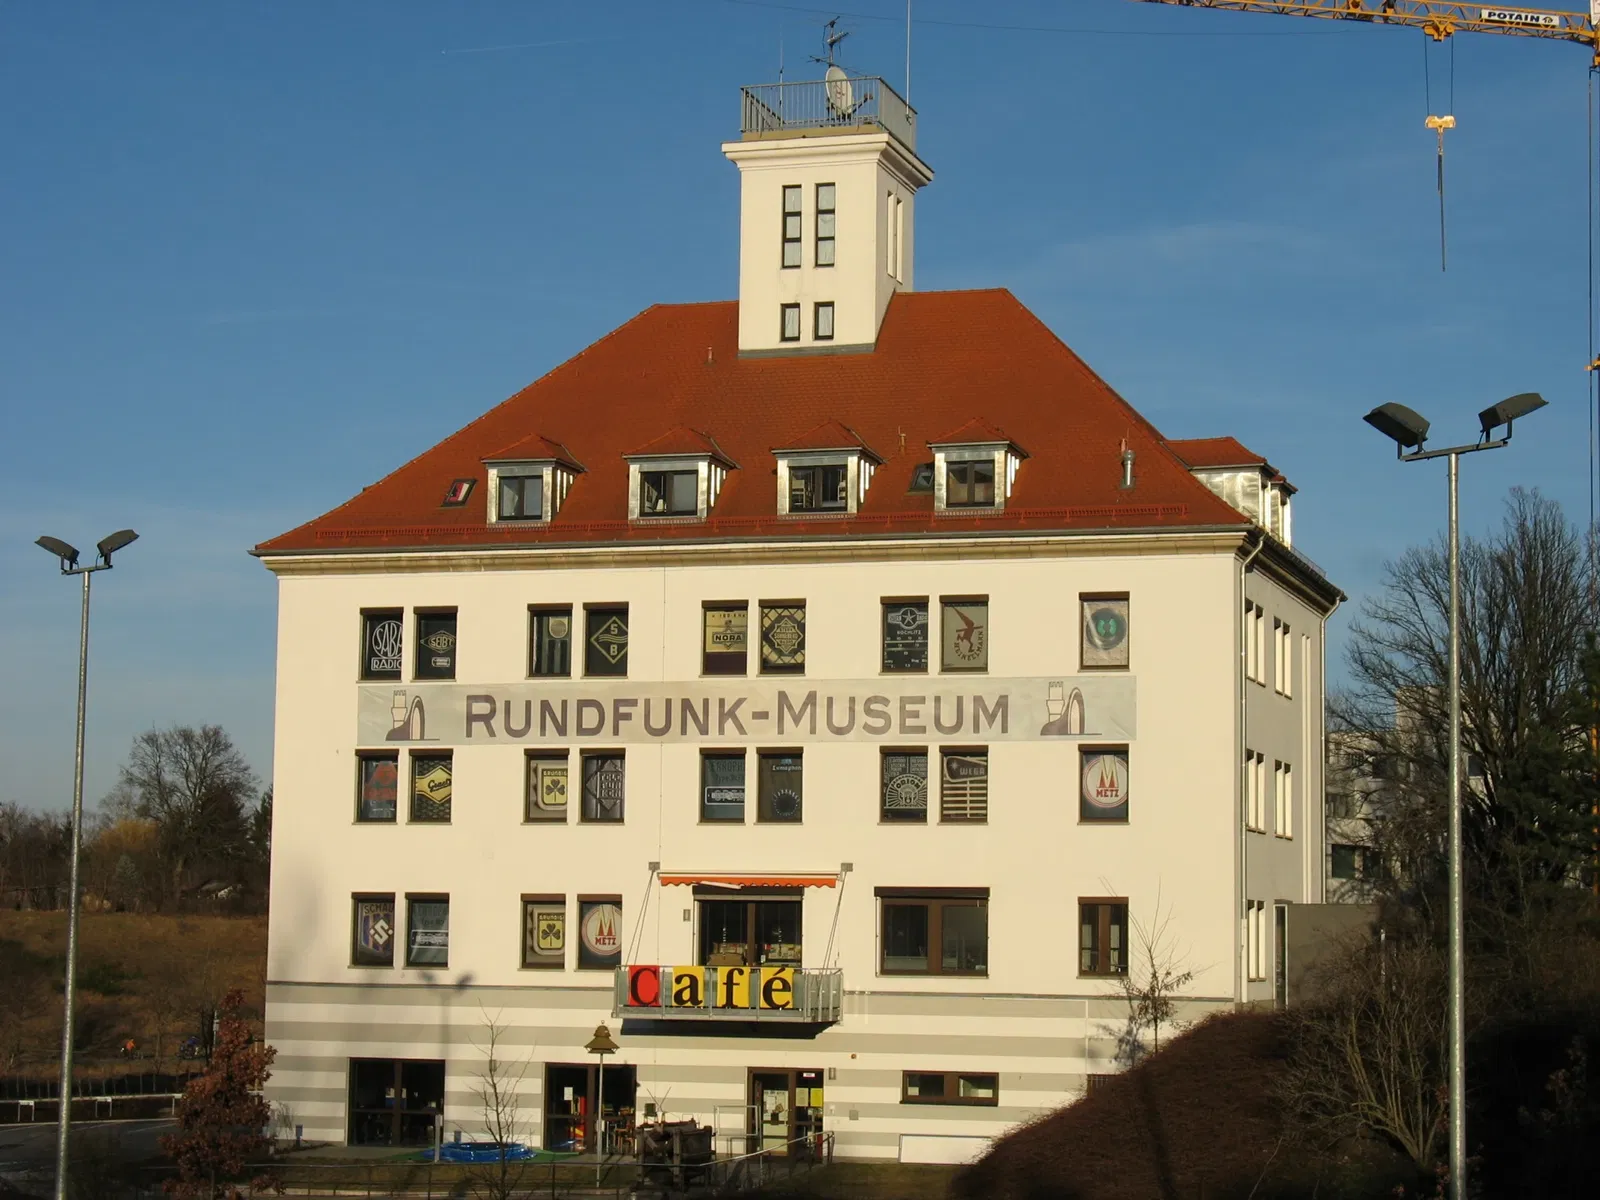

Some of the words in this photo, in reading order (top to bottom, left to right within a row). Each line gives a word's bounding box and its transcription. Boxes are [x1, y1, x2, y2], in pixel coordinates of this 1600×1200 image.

[1487, 11, 1540, 22] POTAIN
[466, 690, 1009, 738] RUNDFUNK-MUSEUM
[959, 767, 985, 776] WEGA
[895, 778, 922, 790] ORION
[1096, 788, 1120, 798] METZ
[595, 937, 617, 946] METZ
[630, 966, 793, 1009] Café
